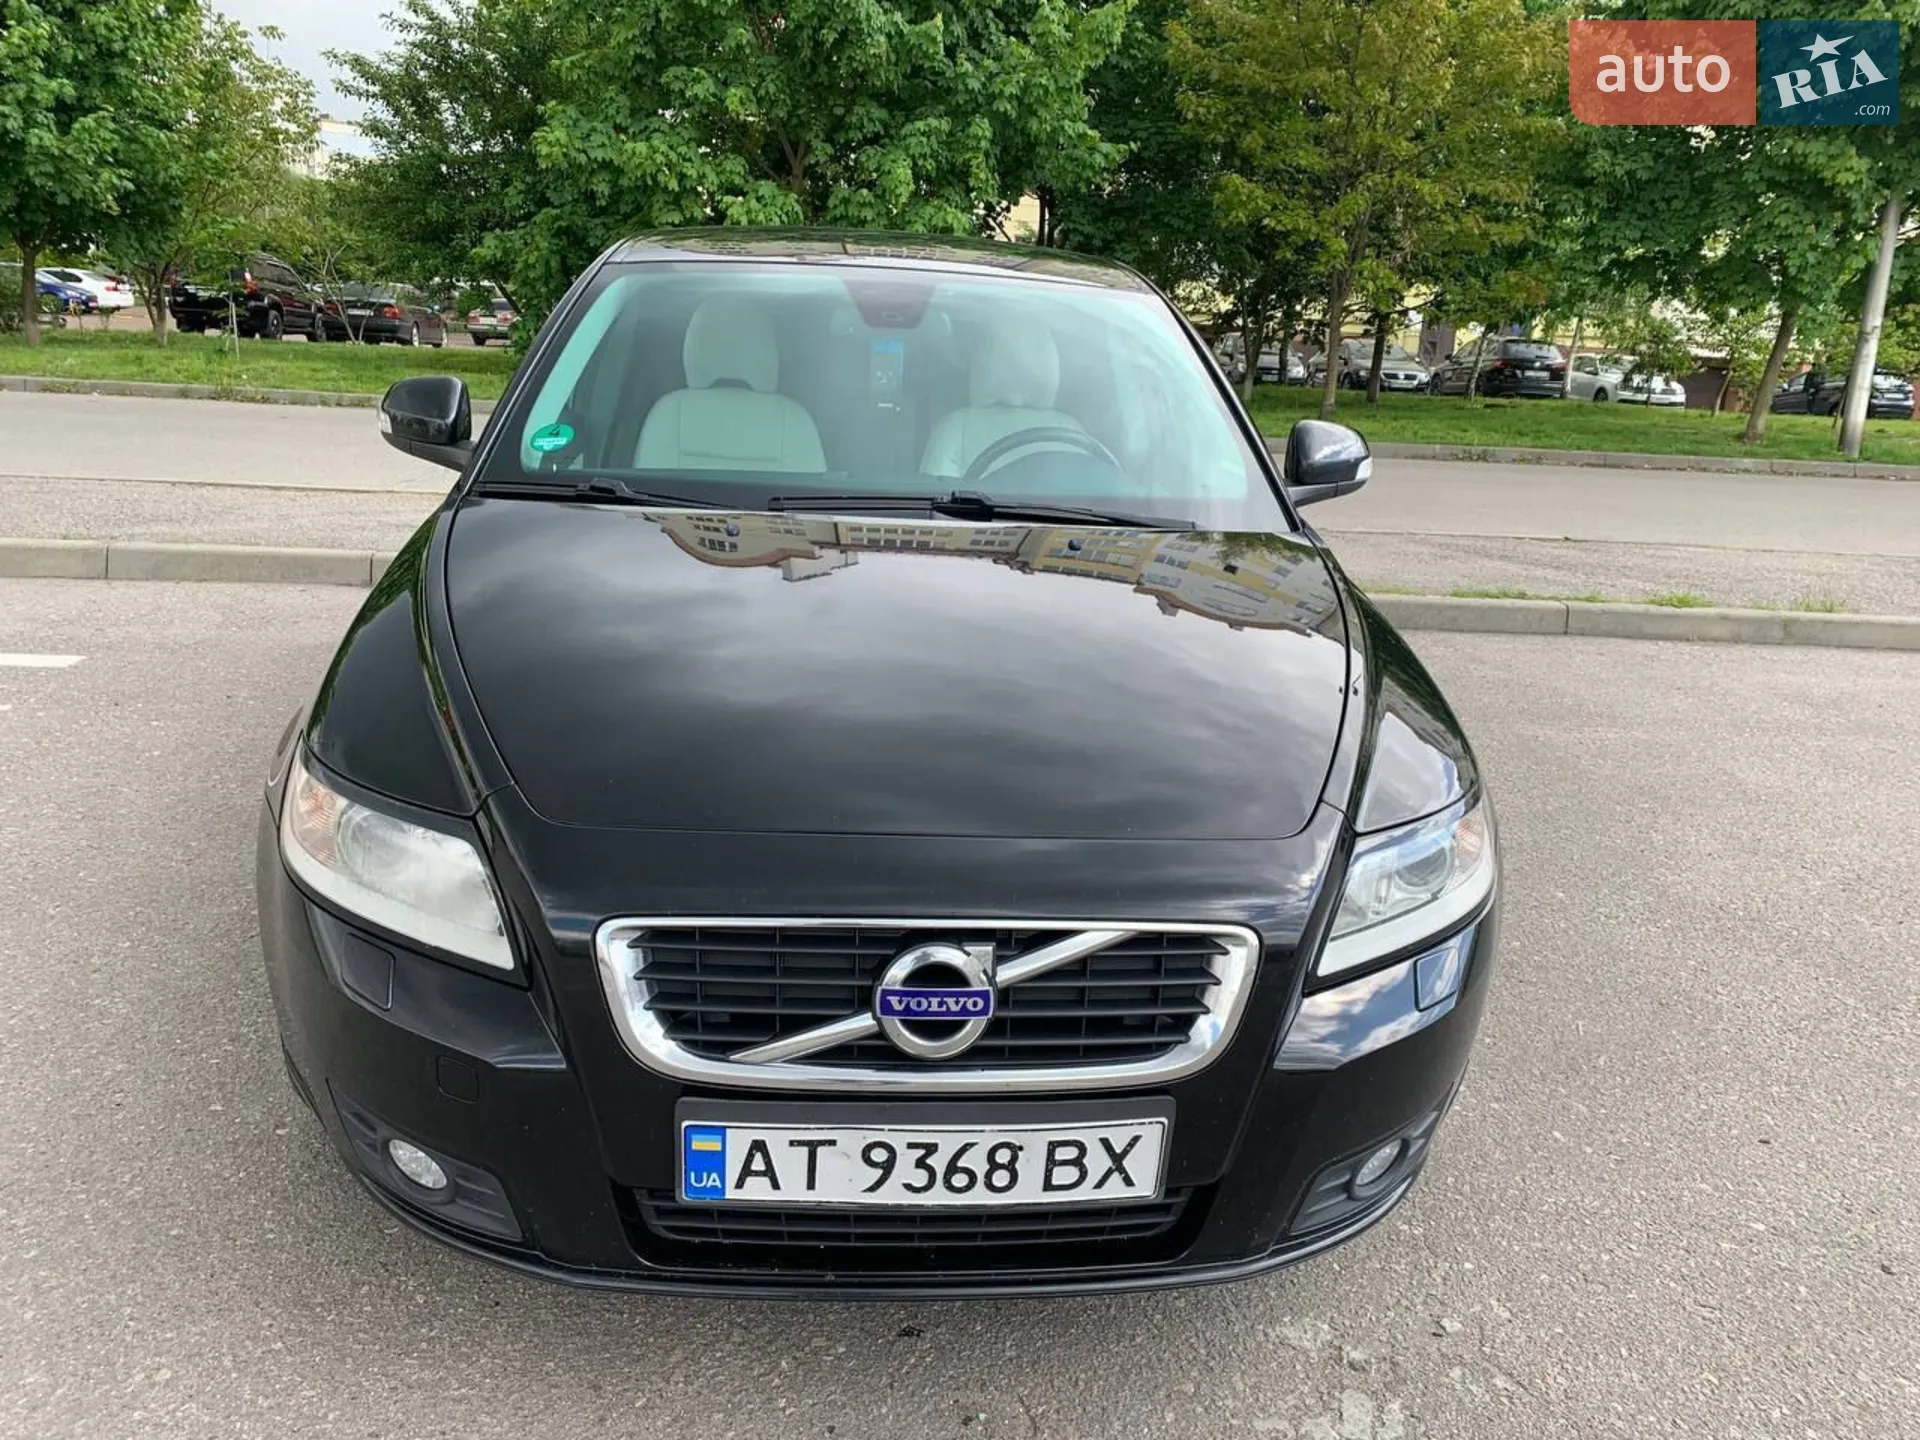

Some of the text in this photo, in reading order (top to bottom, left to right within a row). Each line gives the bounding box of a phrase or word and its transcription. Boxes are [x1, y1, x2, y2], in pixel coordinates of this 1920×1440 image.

[886, 995, 985, 1012] VOLVO
[733, 1134, 1143, 1195] AT 9368 BX
[690, 1171, 722, 1189] UA
